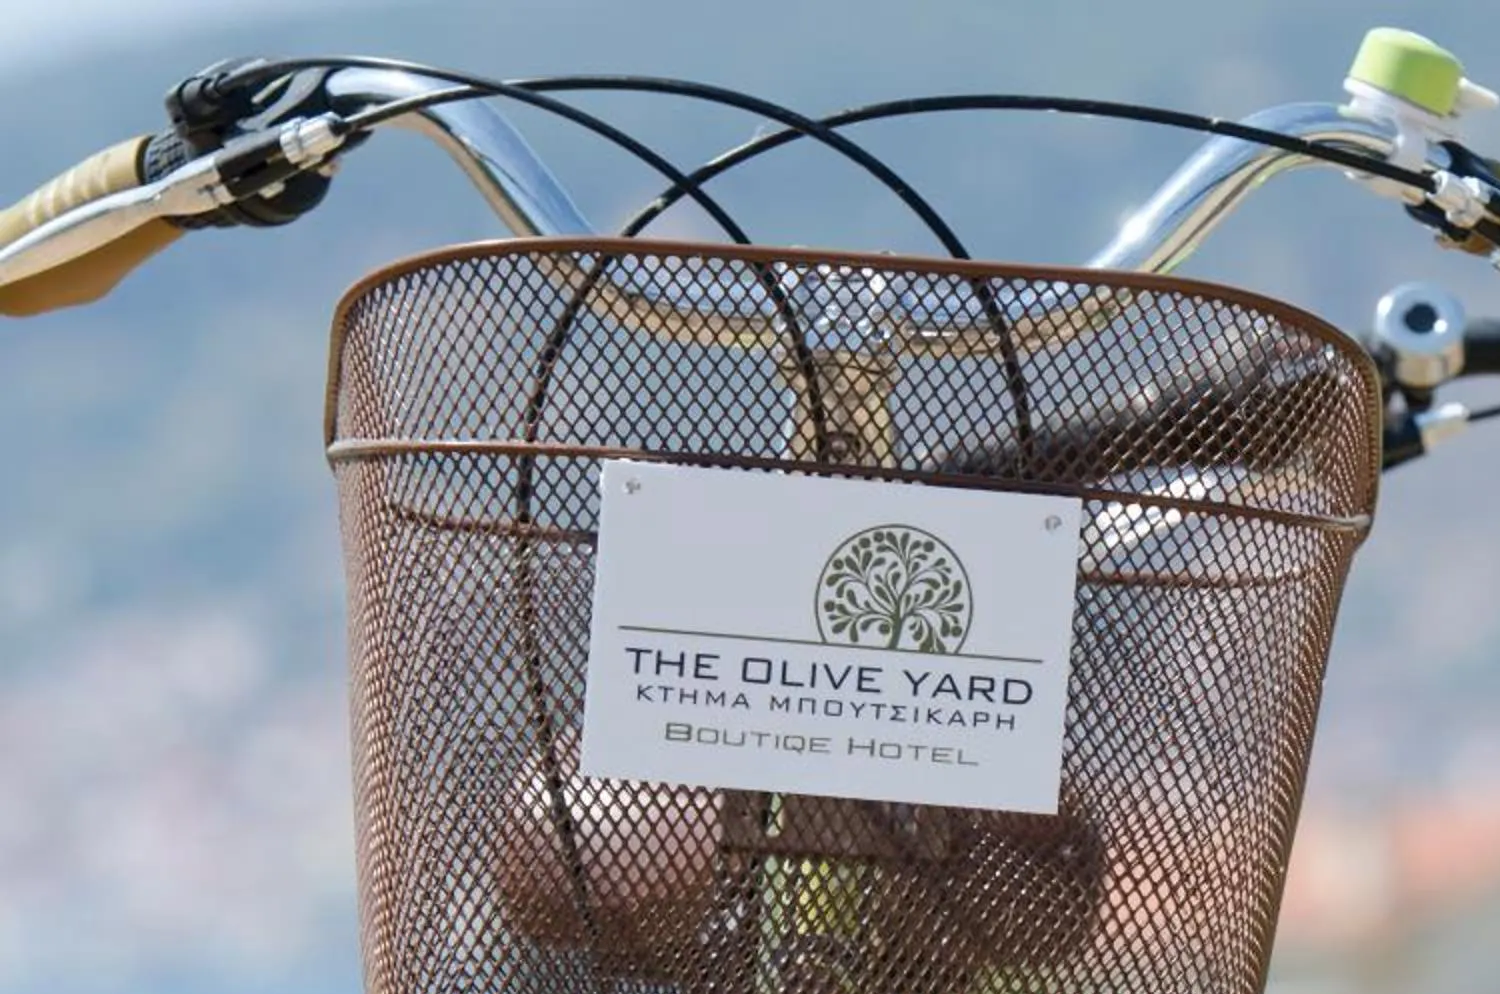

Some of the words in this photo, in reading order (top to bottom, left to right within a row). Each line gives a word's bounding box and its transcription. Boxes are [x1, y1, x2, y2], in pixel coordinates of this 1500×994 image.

[624, 647, 720, 681] THE
[741, 657, 883, 694] OLIVE
[903, 668, 1034, 706] YARD
[637, 684, 750, 710] ΚΤΗΜΑ
[769, 694, 1015, 731] ΜΠΟΥΤΣΙΚΑΡΗ
